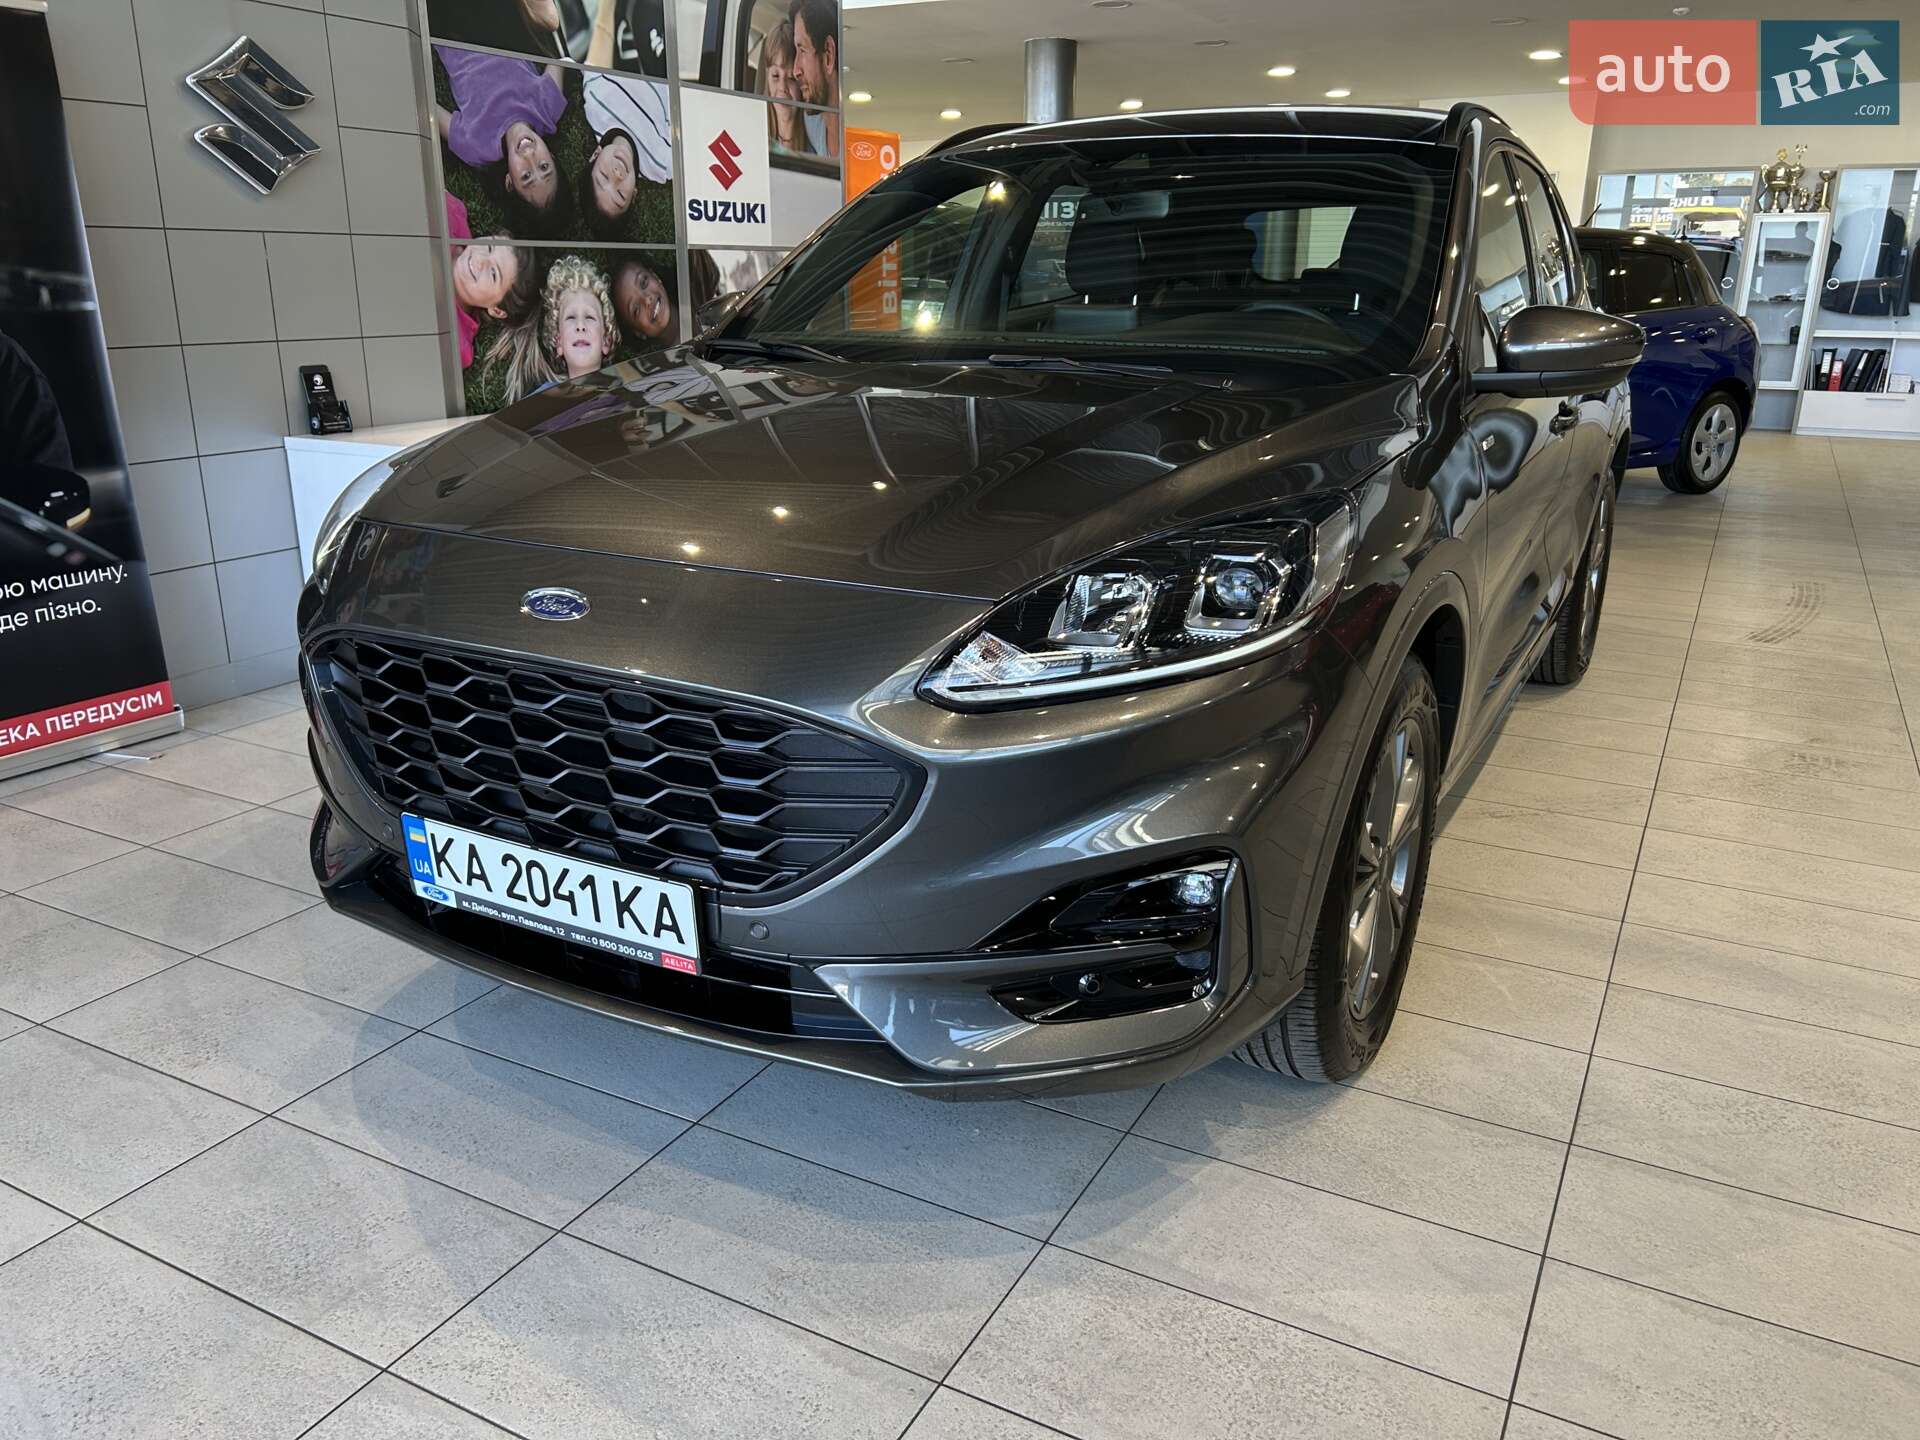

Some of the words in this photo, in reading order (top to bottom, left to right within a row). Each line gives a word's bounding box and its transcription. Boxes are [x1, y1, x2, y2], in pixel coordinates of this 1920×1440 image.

[688, 199, 766, 224] SUZUKI
[31, 563, 128, 594] машину.
[35, 599, 102, 624] пізно.
[45, 691, 163, 734] ПЕРЕДУСІМ
[414, 859, 431, 876] UA
[501, 853, 601, 923] 2041
[471, 902, 501, 917] Дніпро,
[556, 926, 565, 936] 12
[591, 936, 599, 945] 0
[599, 938, 617, 951] 800
[618, 944, 636, 956] 300
[636, 949, 654, 961] 625
[663, 957, 694, 970] AELITA
